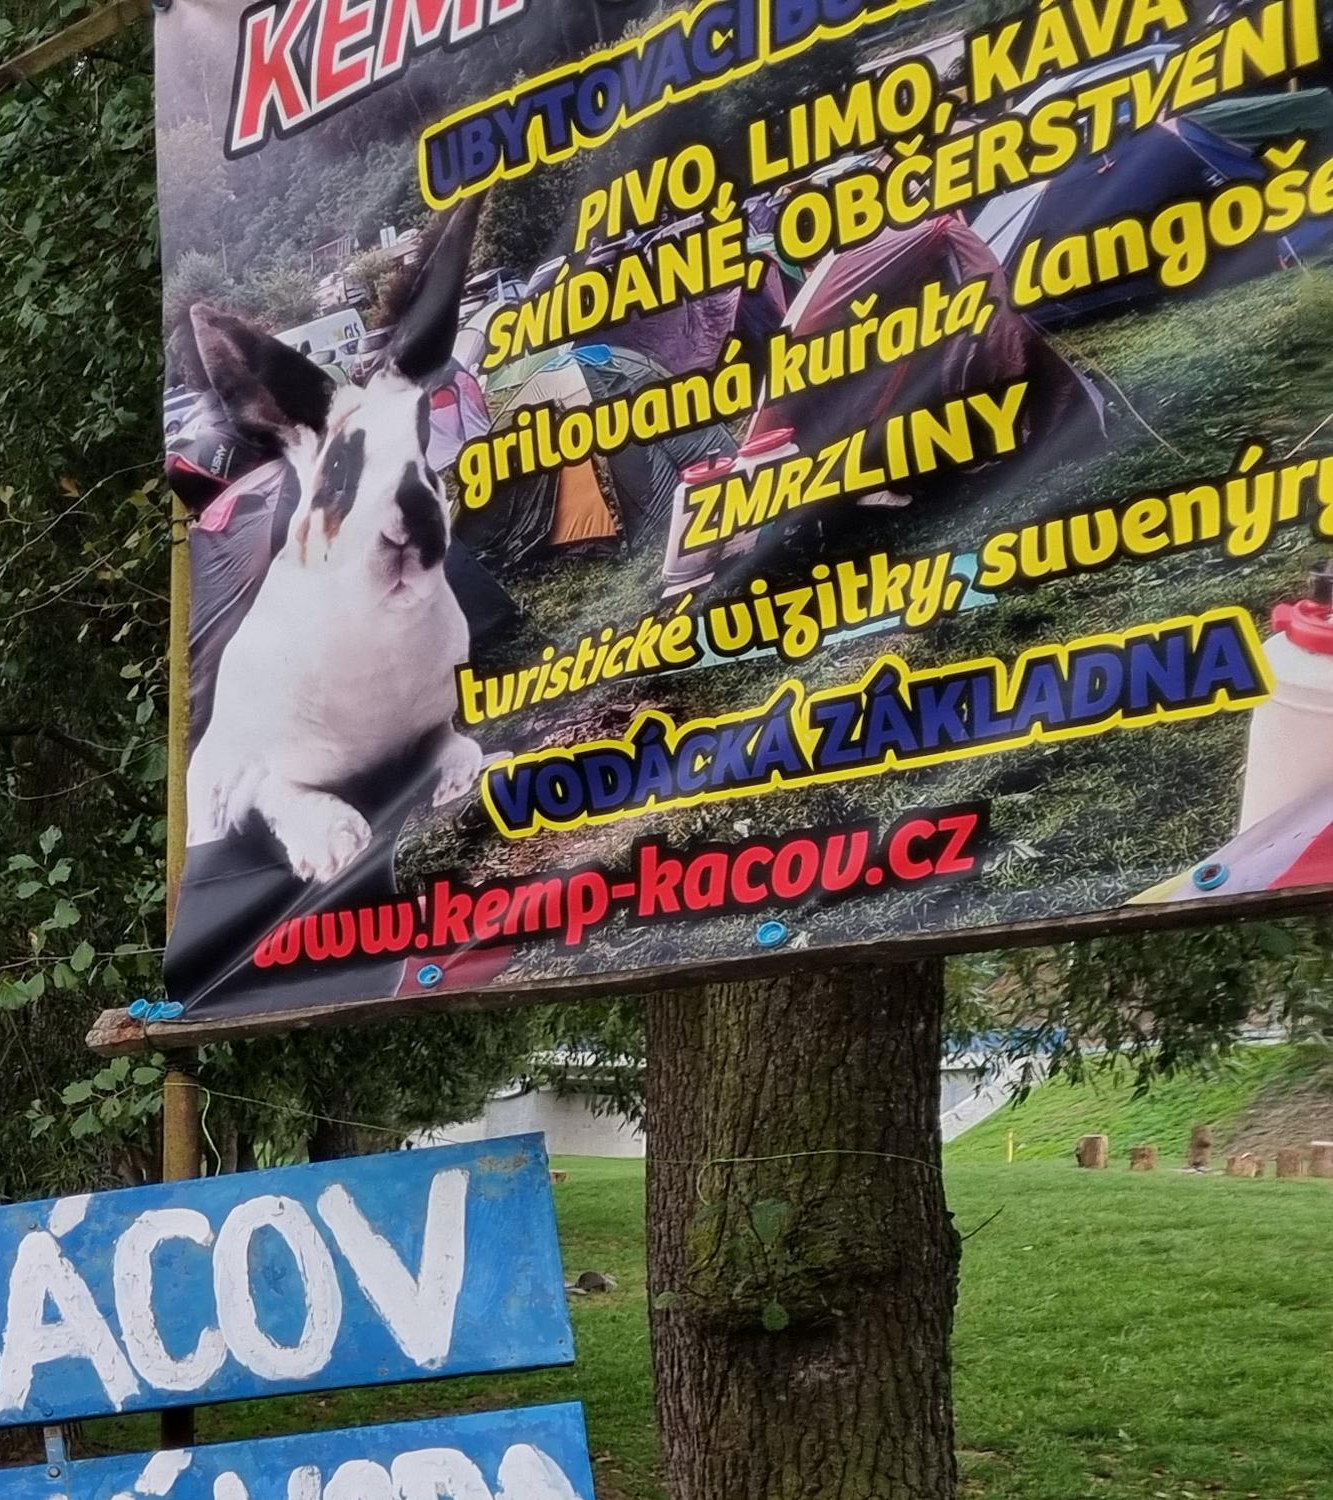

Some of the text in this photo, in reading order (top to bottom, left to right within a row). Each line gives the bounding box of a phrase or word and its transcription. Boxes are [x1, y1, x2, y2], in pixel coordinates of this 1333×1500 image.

[574, 144, 733, 252] PIVO,
[748, 62, 953, 185] LIMO,
[483, 199, 764, 368] SNÍDANĚ,
[459, 340, 753, 509] grilovaná
[770, 280, 994, 399] kuřata,
[684, 382, 1029, 553] ZMRZLINY
[459, 593, 696, 725] turistické
[711, 552, 962, 657] vizitky,
[486, 622, 1263, 833] VODÁCKÁ ZÁKLADNA
[253, 813, 979, 968] www.kemp-kacov.cz
